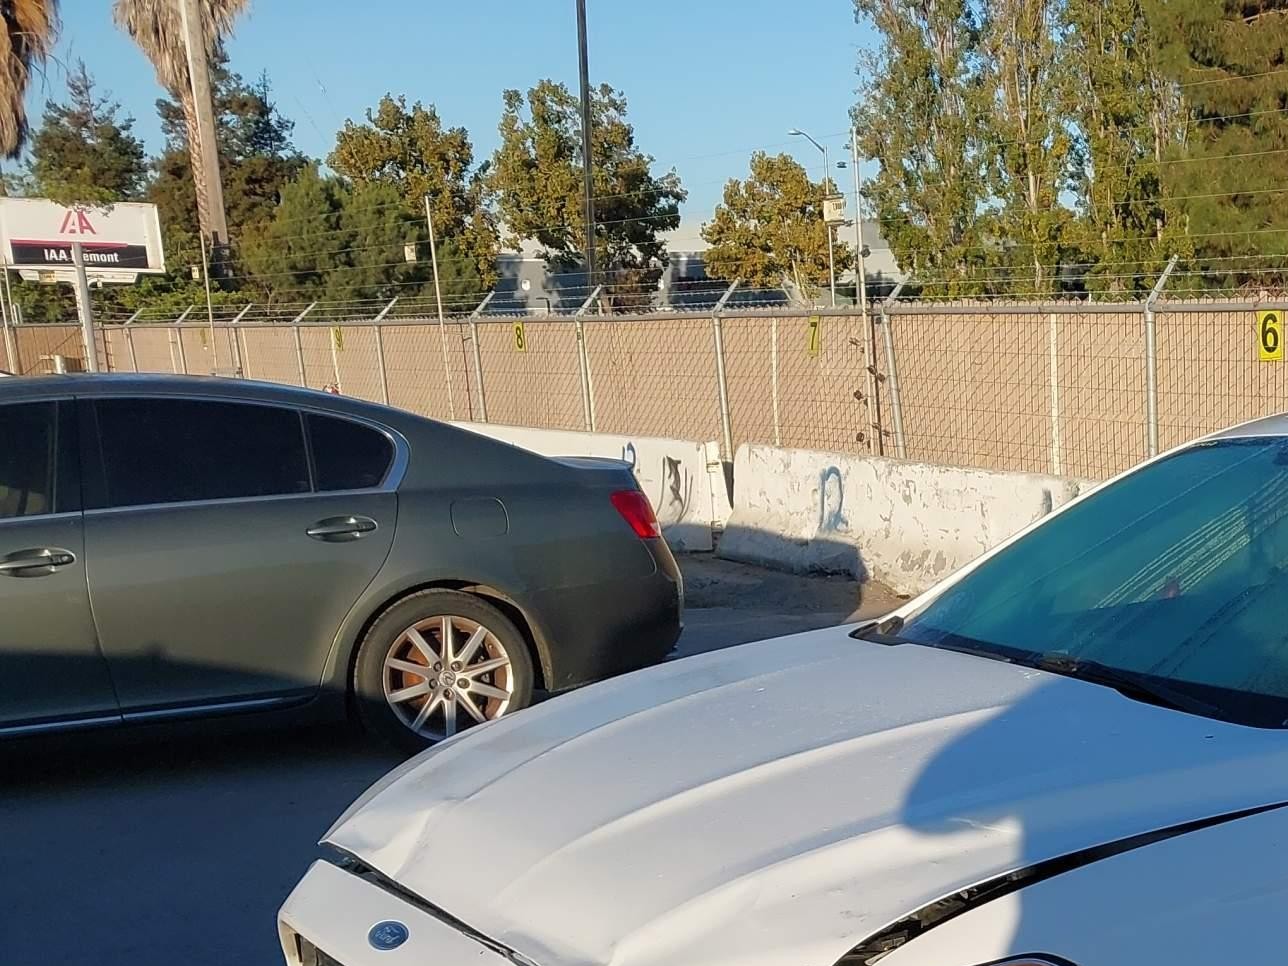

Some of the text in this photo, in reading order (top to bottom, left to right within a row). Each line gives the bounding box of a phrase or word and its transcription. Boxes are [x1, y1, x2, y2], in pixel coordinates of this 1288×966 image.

[44, 249, 119, 263] IAA emont
[515, 325, 523, 349] 8
[810, 321, 818, 351] 7
[1261, 313, 1279, 353] 6
